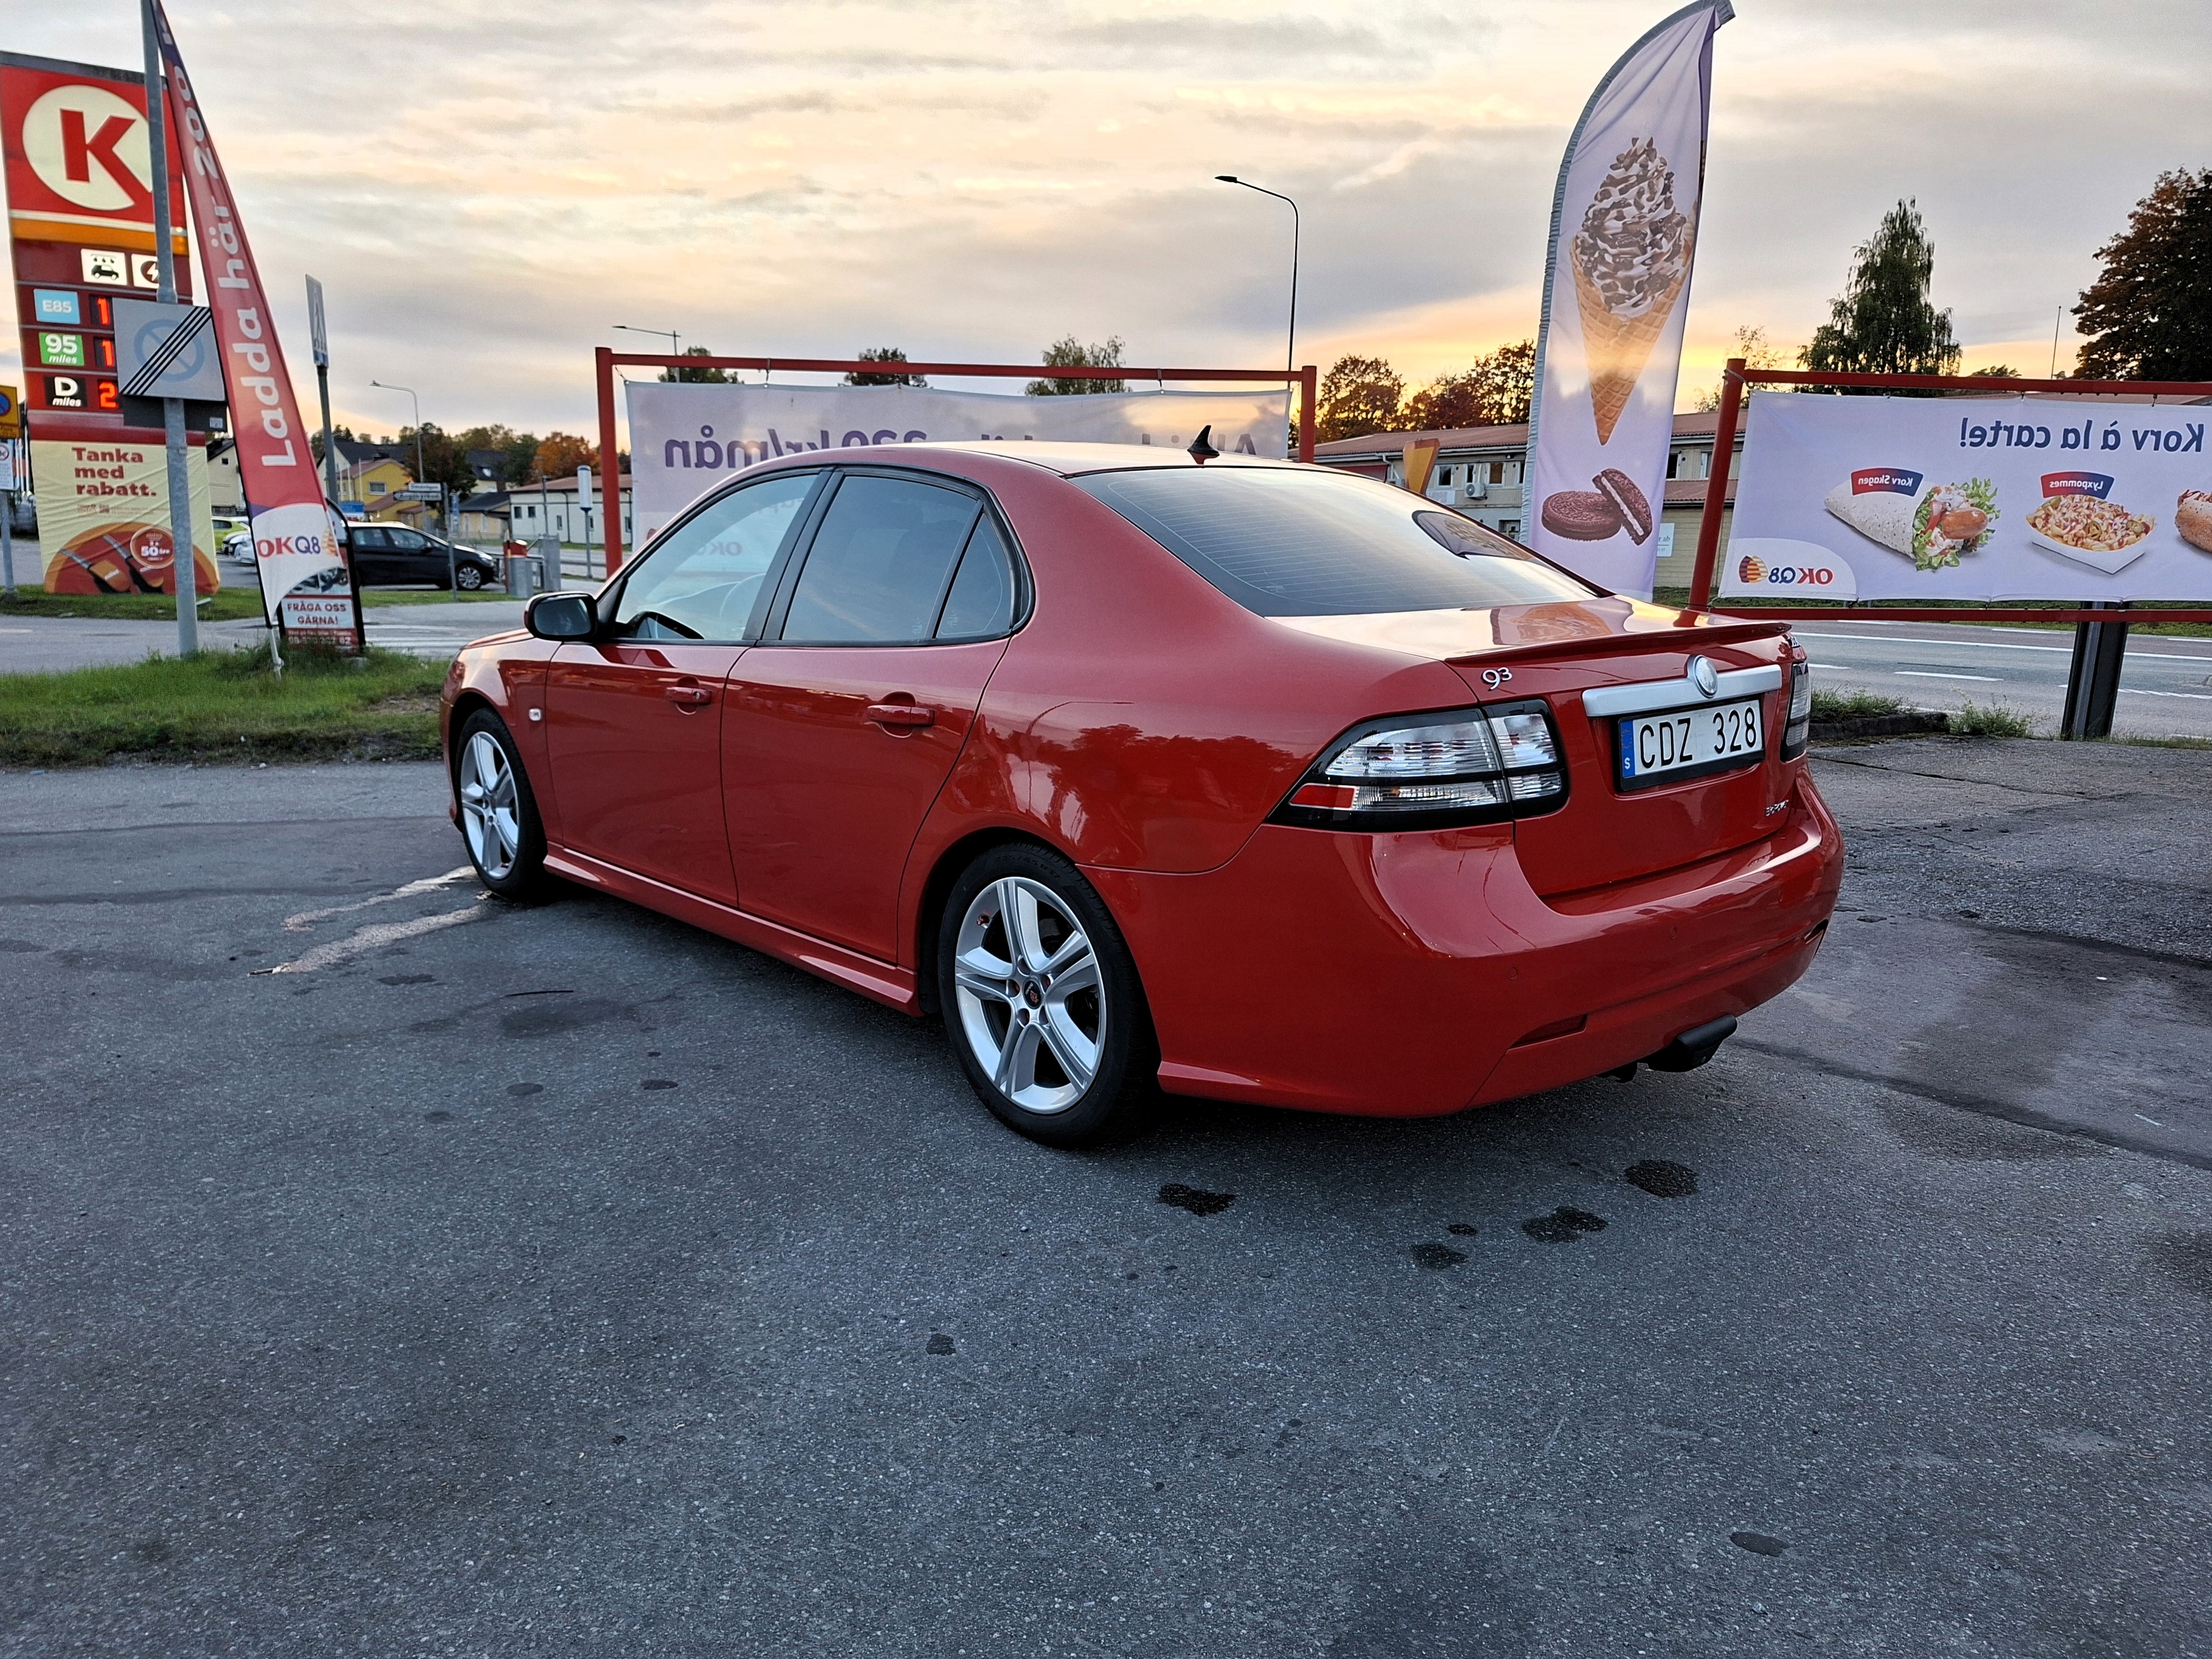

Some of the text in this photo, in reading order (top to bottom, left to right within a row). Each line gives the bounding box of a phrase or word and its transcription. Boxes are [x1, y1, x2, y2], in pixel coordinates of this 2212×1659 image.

[59, 107, 152, 205] K
[208, 195, 251, 290] här
[41, 299, 72, 314] E85
[45, 333, 78, 355] 95
[48, 354, 77, 364] miles
[54, 376, 79, 397] D
[232, 307, 298, 466] Ladda
[52, 397, 82, 407] miles
[71, 446, 144, 463] Tanka
[74, 464, 124, 479] med
[76, 481, 157, 497] rabatt.
[140, 545, 159, 557] 50
[256, 535, 321, 557] OKQ8
[287, 601, 347, 612] FRÅGA OSS
[297, 614, 338, 625] GÄRNA!
[1640, 707, 1757, 769] CDZ 328
[1624, 757, 1631, 769] S
